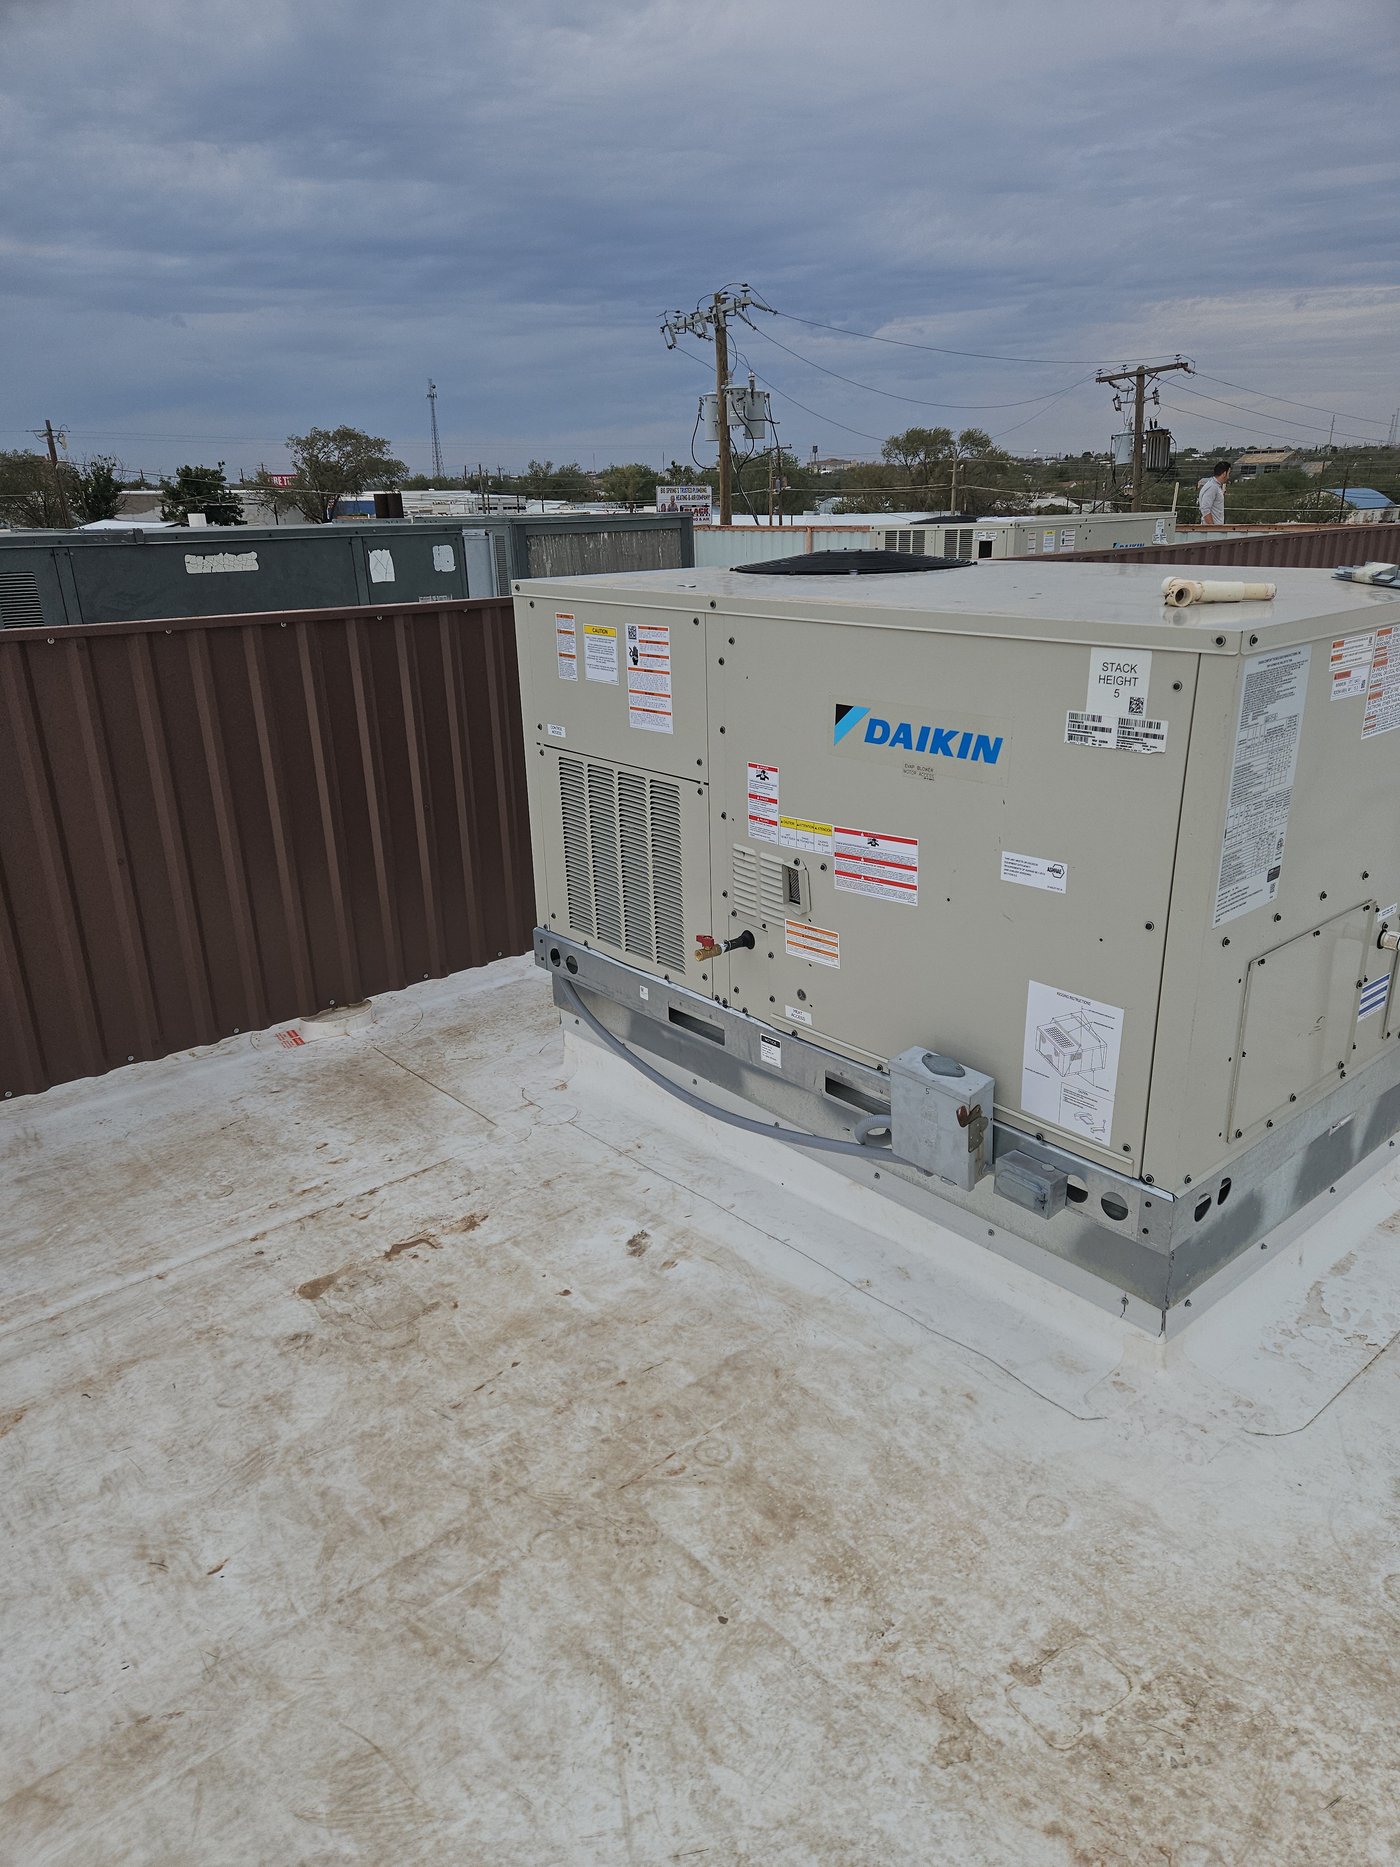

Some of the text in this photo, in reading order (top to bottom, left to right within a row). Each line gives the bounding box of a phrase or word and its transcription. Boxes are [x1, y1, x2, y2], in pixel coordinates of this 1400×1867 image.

[1101, 662, 1138, 674] STACK
[1098, 675, 1139, 687] HEIGHT
[1113, 688, 1120, 698] 5
[864, 718, 1004, 764] DAIKIN
